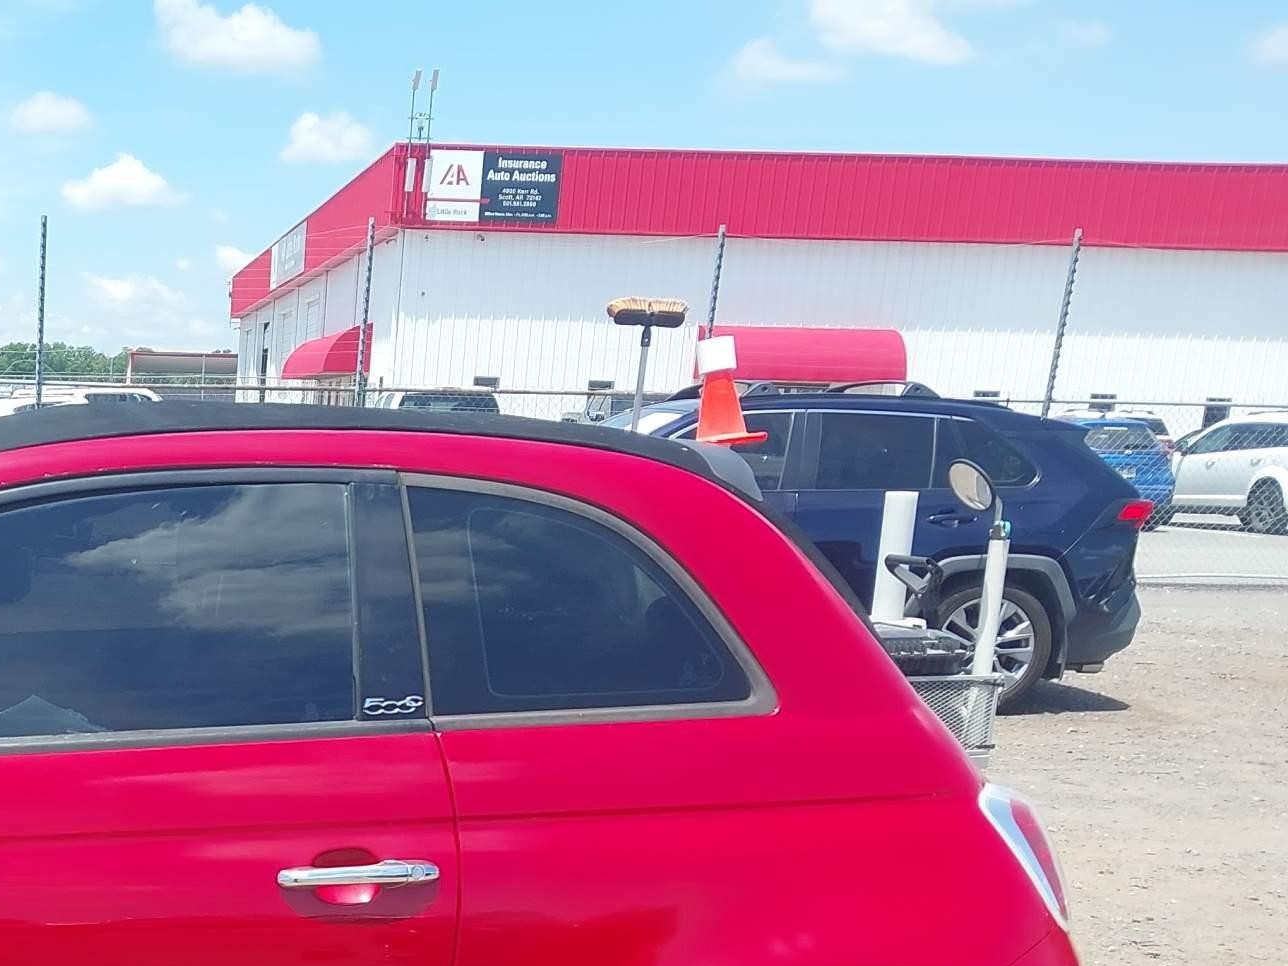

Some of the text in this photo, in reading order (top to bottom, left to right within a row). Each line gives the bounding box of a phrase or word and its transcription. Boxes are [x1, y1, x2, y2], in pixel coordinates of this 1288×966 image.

[498, 157, 547, 169] Insurance
[487, 169, 556, 182] Auto Auctions
